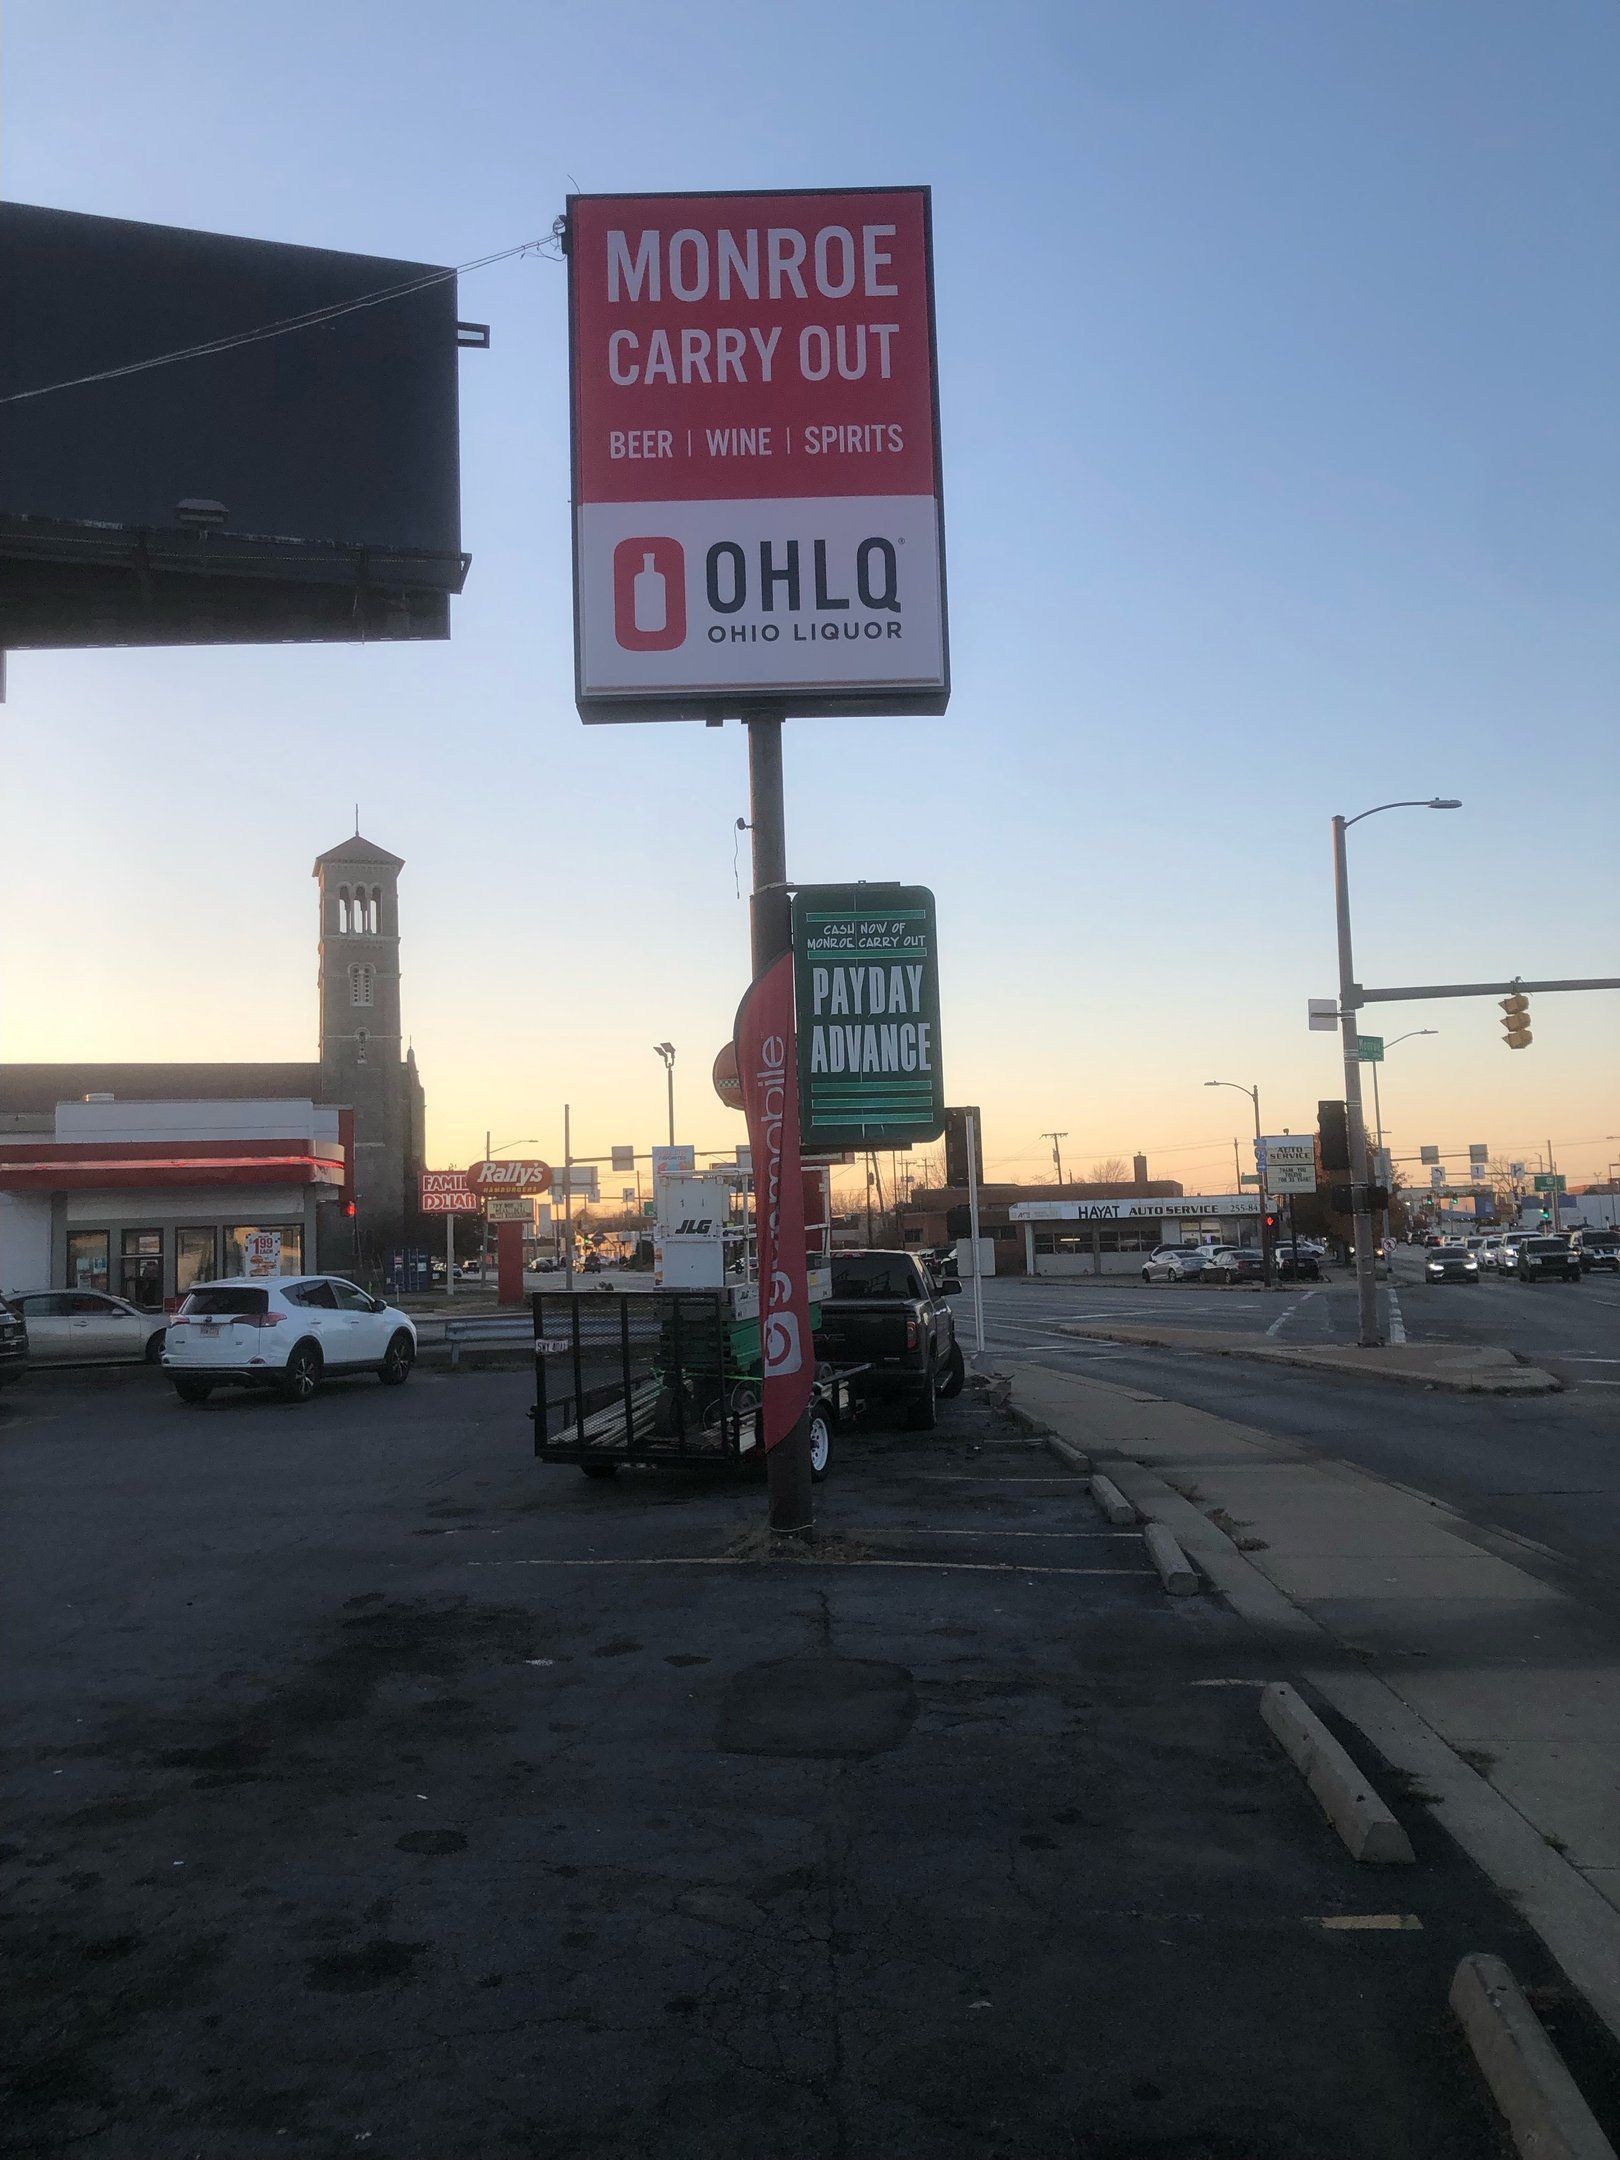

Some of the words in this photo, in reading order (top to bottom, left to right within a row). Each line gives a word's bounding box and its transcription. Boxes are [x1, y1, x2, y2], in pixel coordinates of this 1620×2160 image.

[606, 224, 900, 302] MONROE
[608, 326, 783, 386] CARRY
[799, 323, 900, 382] OUT
[609, 431, 673, 459] BEER
[706, 427, 772, 456] WINE
[804, 424, 904, 454] SPIRITS
[705, 537, 903, 614] OHLQ
[707, 624, 780, 643] OHIO
[794, 621, 903, 642] LIQUOR
[860, 922, 888, 934] NOW
[891, 922, 906, 935] OF
[807, 936, 855, 950] MONROE
[858, 936, 900, 948] CARRY
[903, 935, 926, 947] OUT
[812, 964, 923, 1017] PAYDAY
[811, 1022, 932, 1074] ADVANCE
[1269, 1152, 1311, 1160] SERVICE
[1277, 1146, 1303, 1154] AUTO
[423, 1174, 469, 1191] FAMIL
[476, 1162, 544, 1187] Rally's
[423, 1192, 477, 1211] DOLLAR
[1078, 1205, 1120, 1219] HAYAT
[1129, 1206, 1163, 1216] AUTO
[1165, 1204, 1219, 1215] SERVICE
[1230, 1203, 1269, 1213] 255-843
[675, 1219, 713, 1235] JLG
